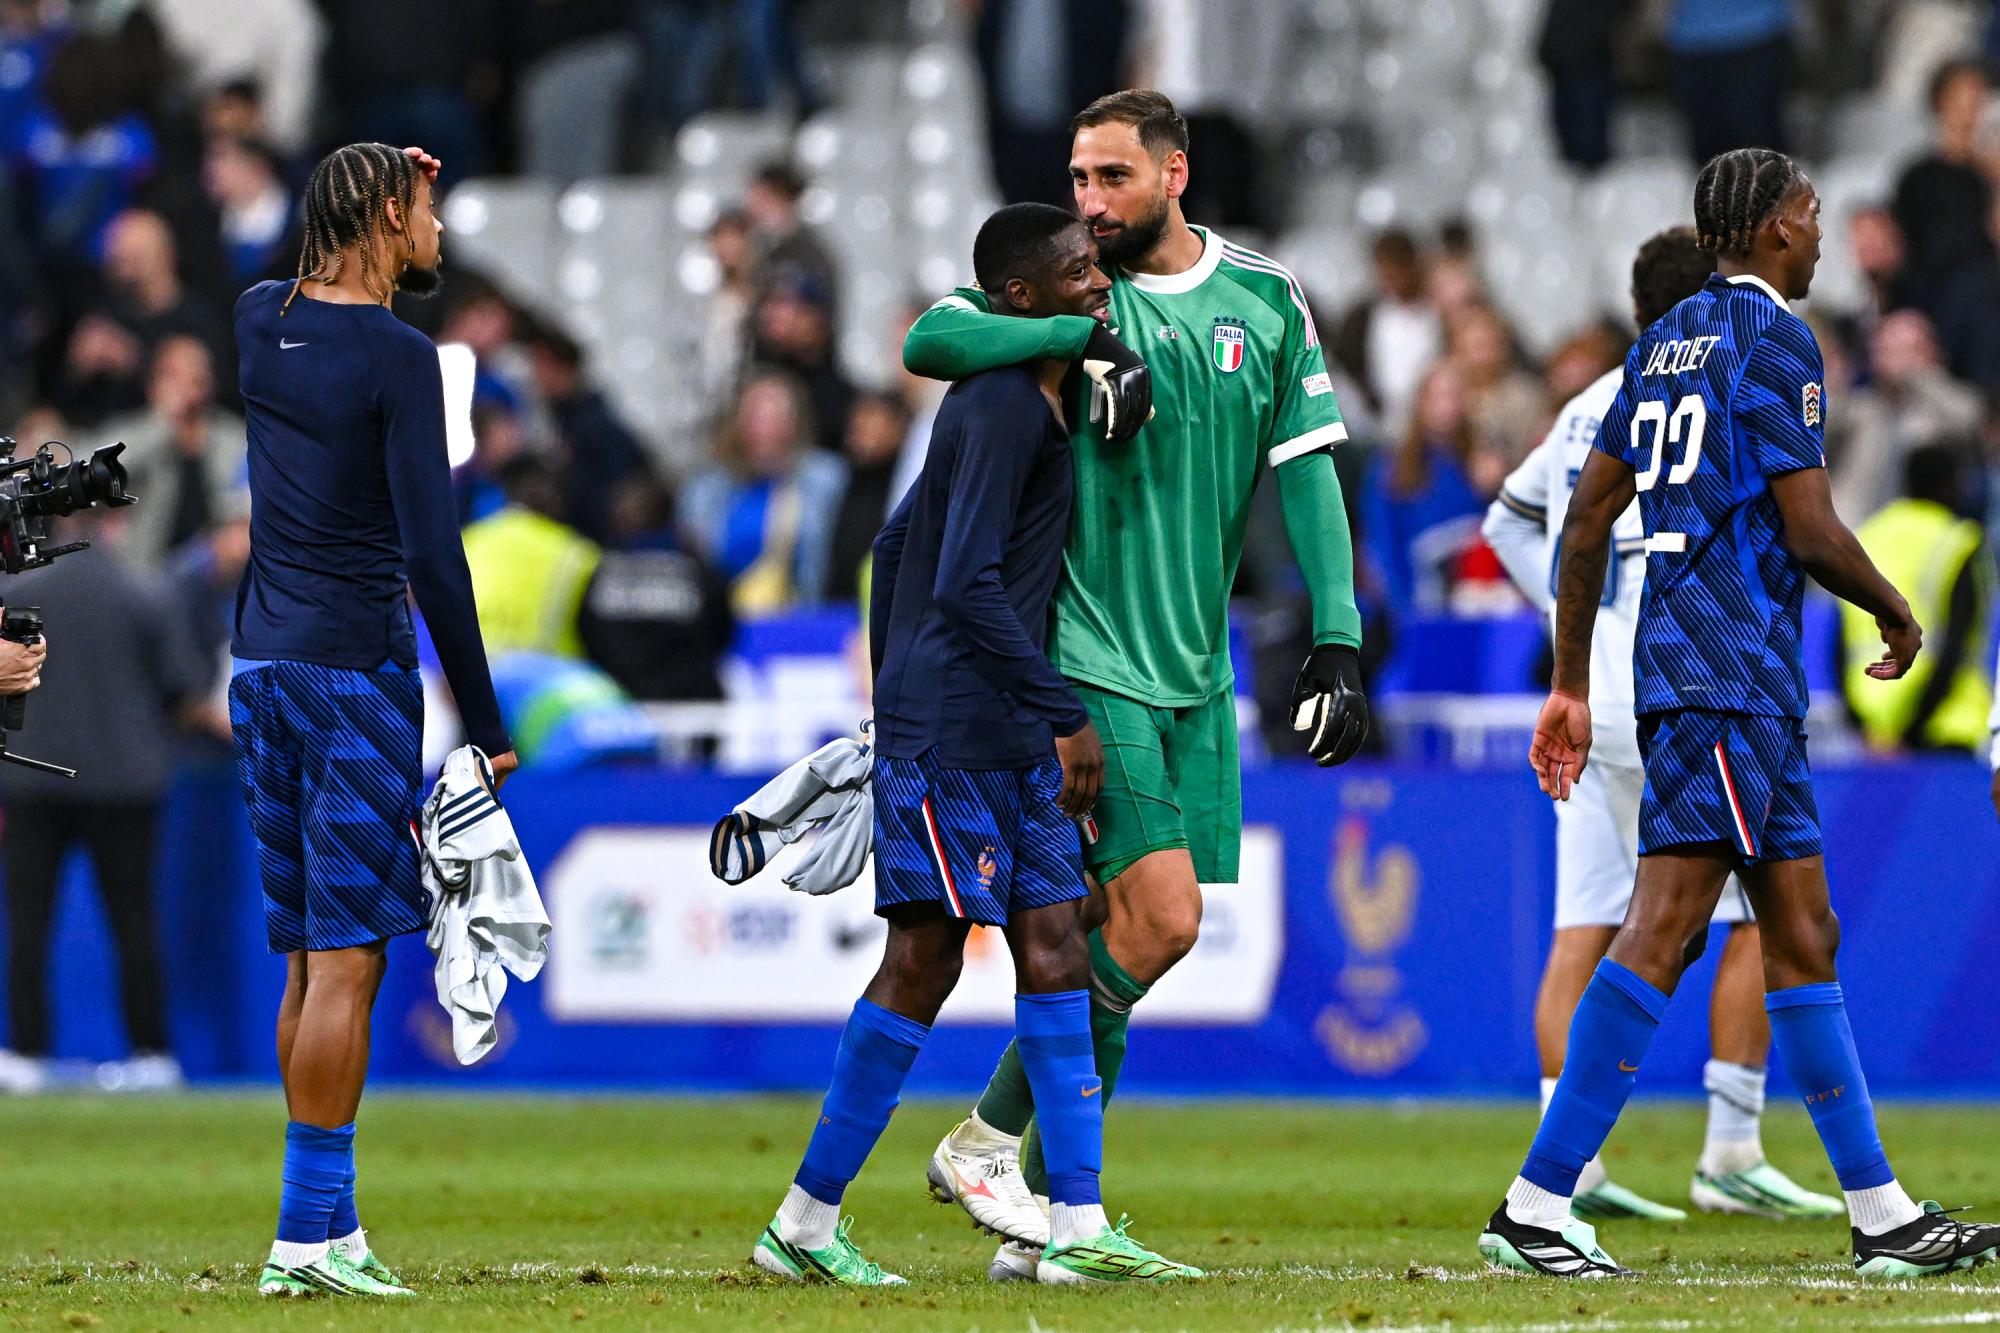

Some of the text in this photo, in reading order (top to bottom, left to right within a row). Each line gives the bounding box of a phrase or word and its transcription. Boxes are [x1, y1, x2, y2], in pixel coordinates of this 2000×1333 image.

[1215, 328, 1243, 340] ITALIA
[1641, 335, 1721, 377] JACQUET
[1048, 1246, 1179, 1279] F50
